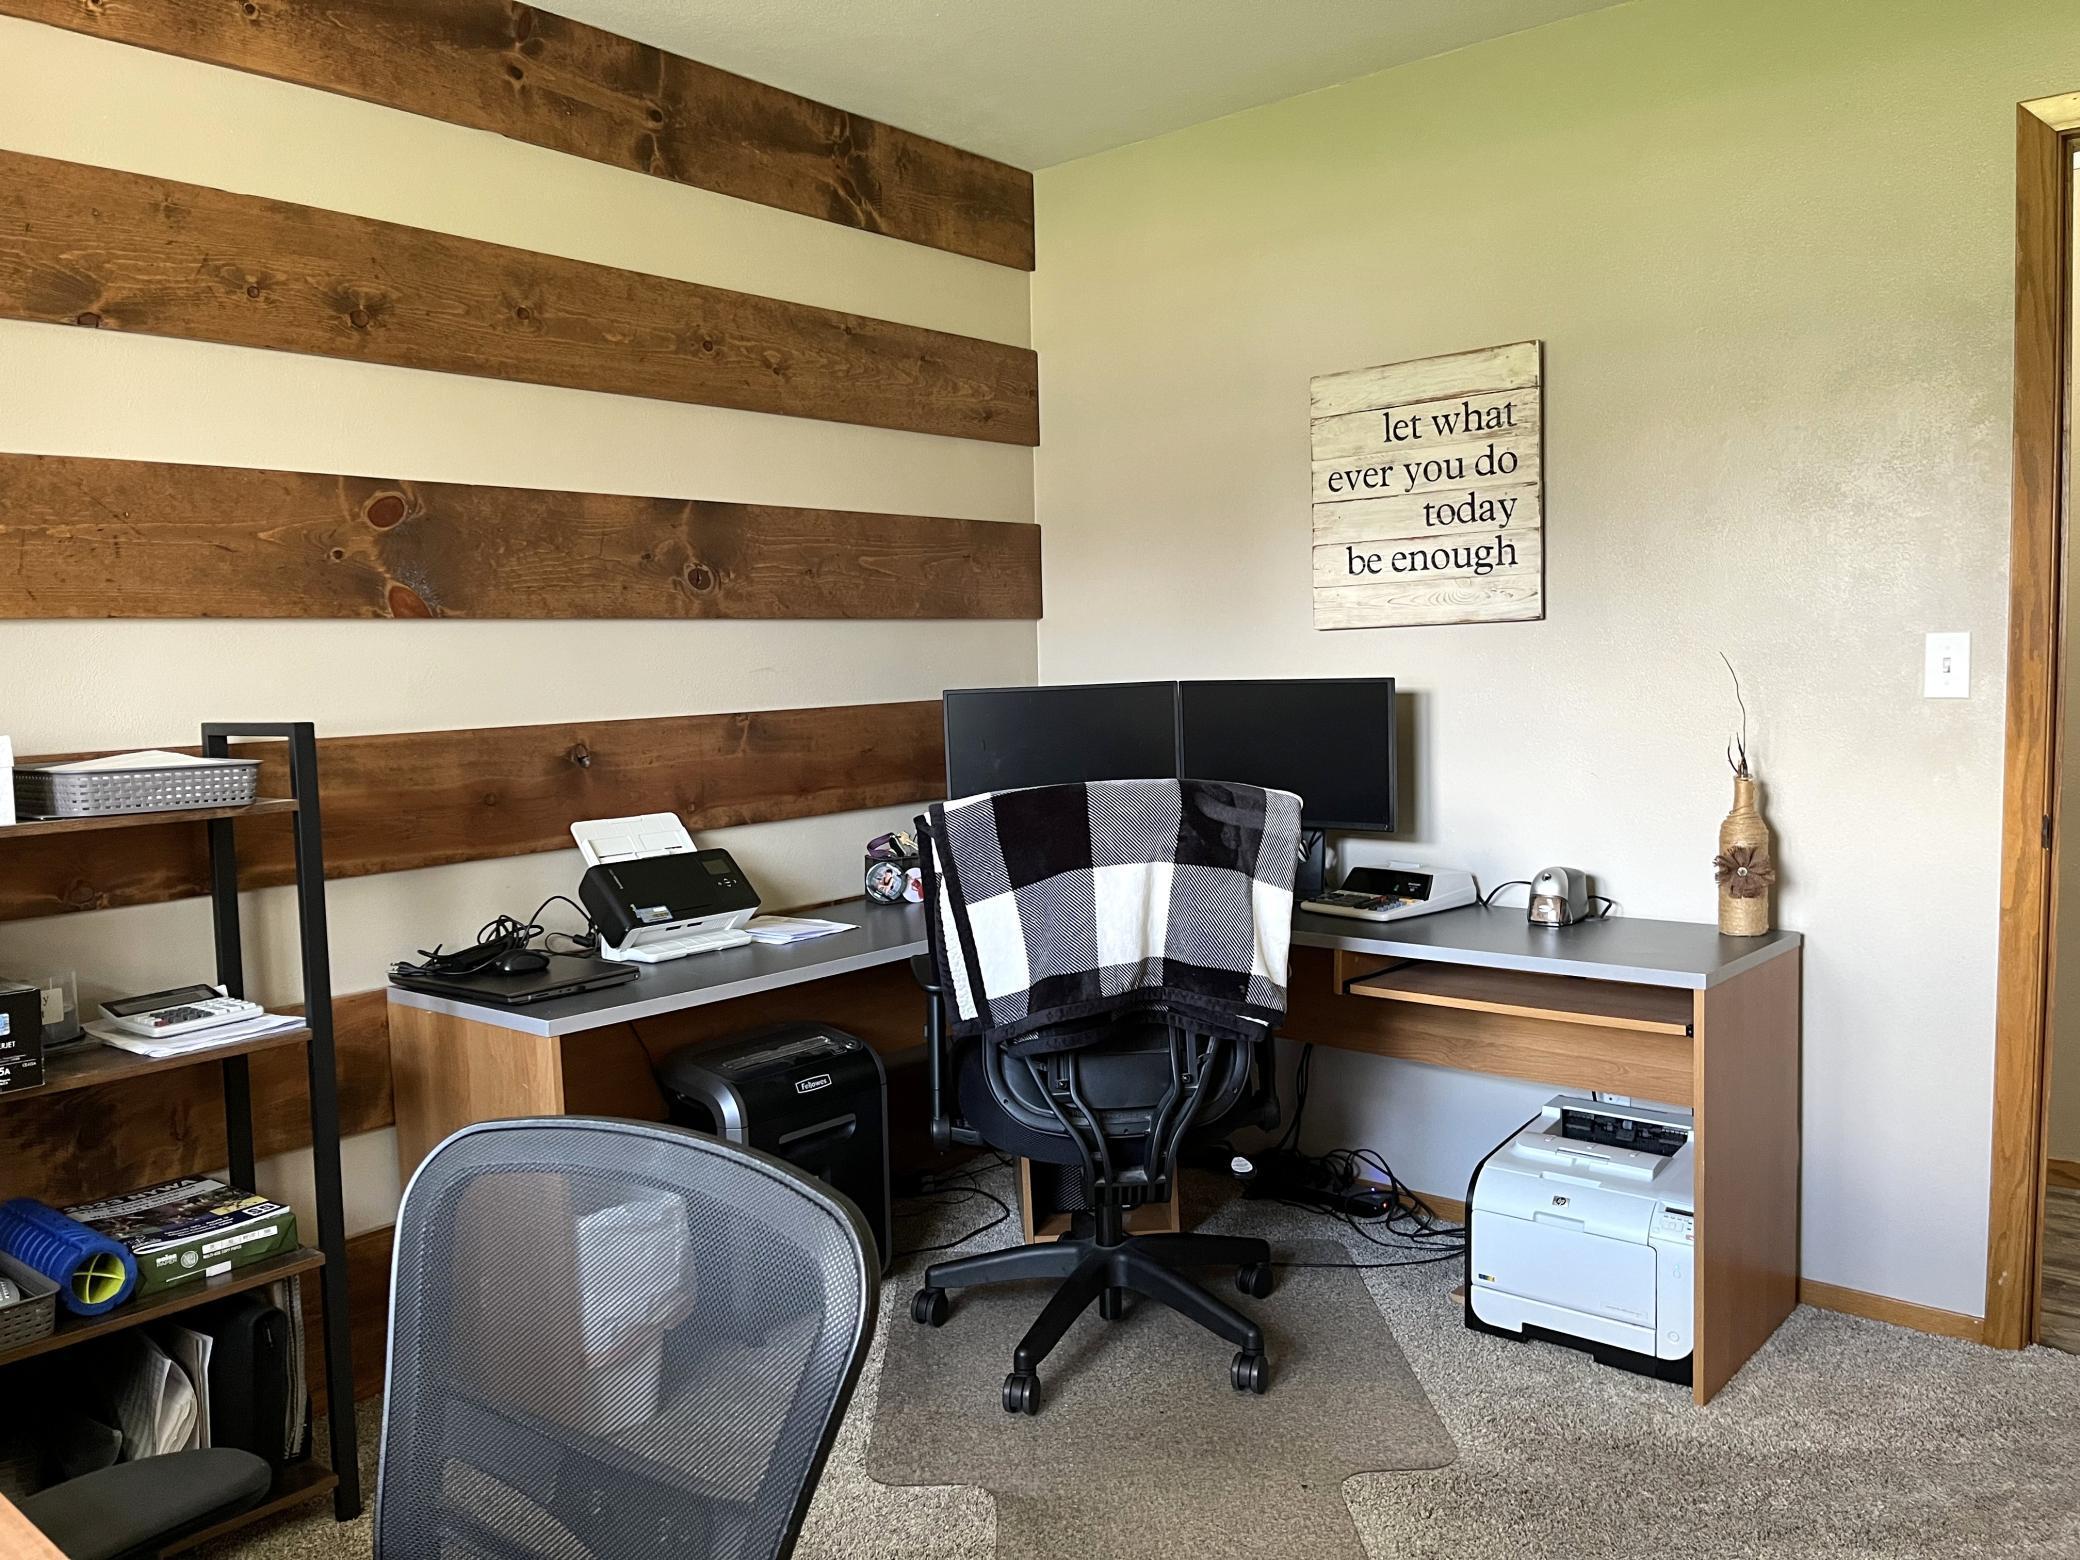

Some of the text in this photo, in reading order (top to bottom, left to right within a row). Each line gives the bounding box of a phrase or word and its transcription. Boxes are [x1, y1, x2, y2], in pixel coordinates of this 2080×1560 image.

[1382, 401, 1518, 443] let what
[1328, 443, 1518, 493] ever you do
[1423, 491, 1518, 529] today
[1346, 534, 1519, 576] be enough
[0, 1040, 16, 1049] RJET
[801, 1078, 827, 1090] Fellowes
